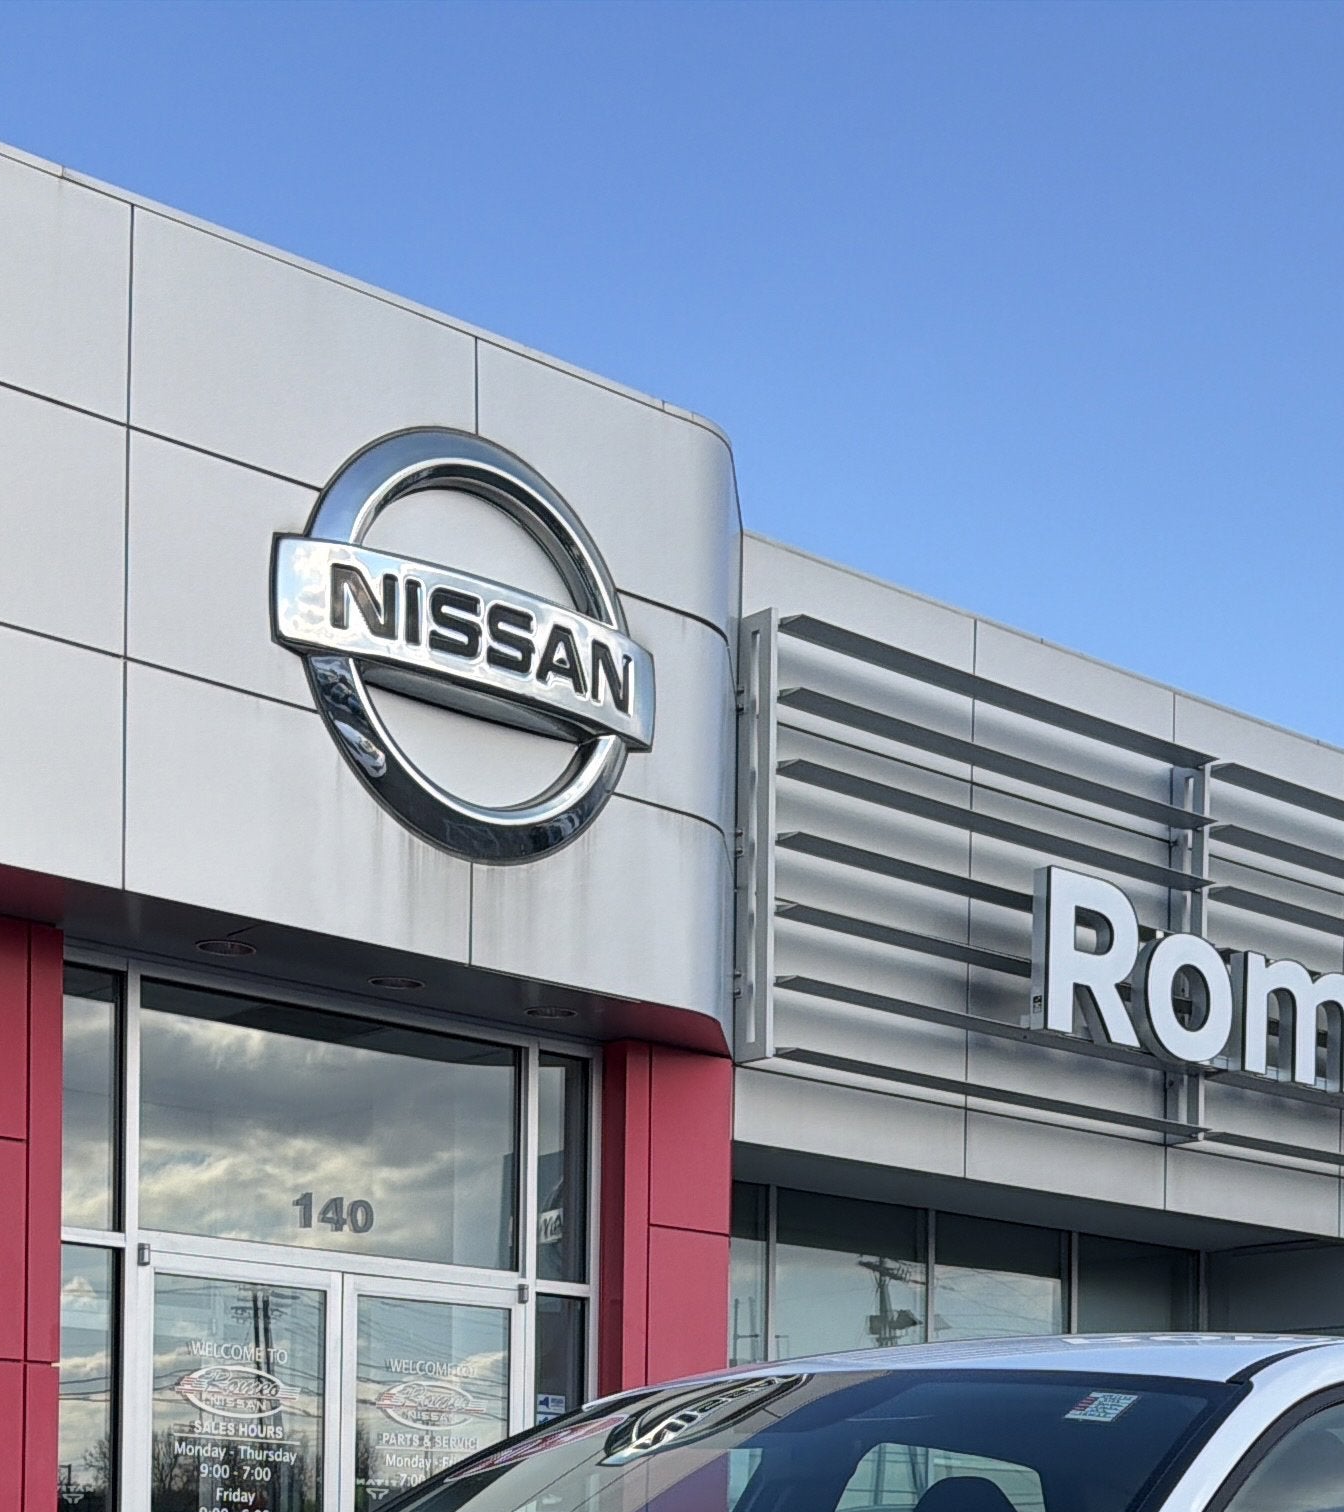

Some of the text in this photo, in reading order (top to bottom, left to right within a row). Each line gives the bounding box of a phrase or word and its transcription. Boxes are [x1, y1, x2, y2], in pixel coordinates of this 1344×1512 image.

[330, 562, 633, 718] NISSAN
[292, 1192, 374, 1234] 140
[191, 1340, 288, 1364] WELCOME TO
[407, 1410, 458, 1423] NISSA
[193, 1419, 284, 1439] SALES HOURS
[382, 1432, 420, 1448] PARTS
[422, 1435, 432, 1448] &
[174, 1441, 227, 1461] Monday
[238, 1445, 298, 1466] Thursday
[385, 1453, 432, 1471] Monday
[199, 1463, 230, 1479] 9:00
[242, 1465, 272, 1482] 7:00
[216, 1487, 256, 1505] Friday
